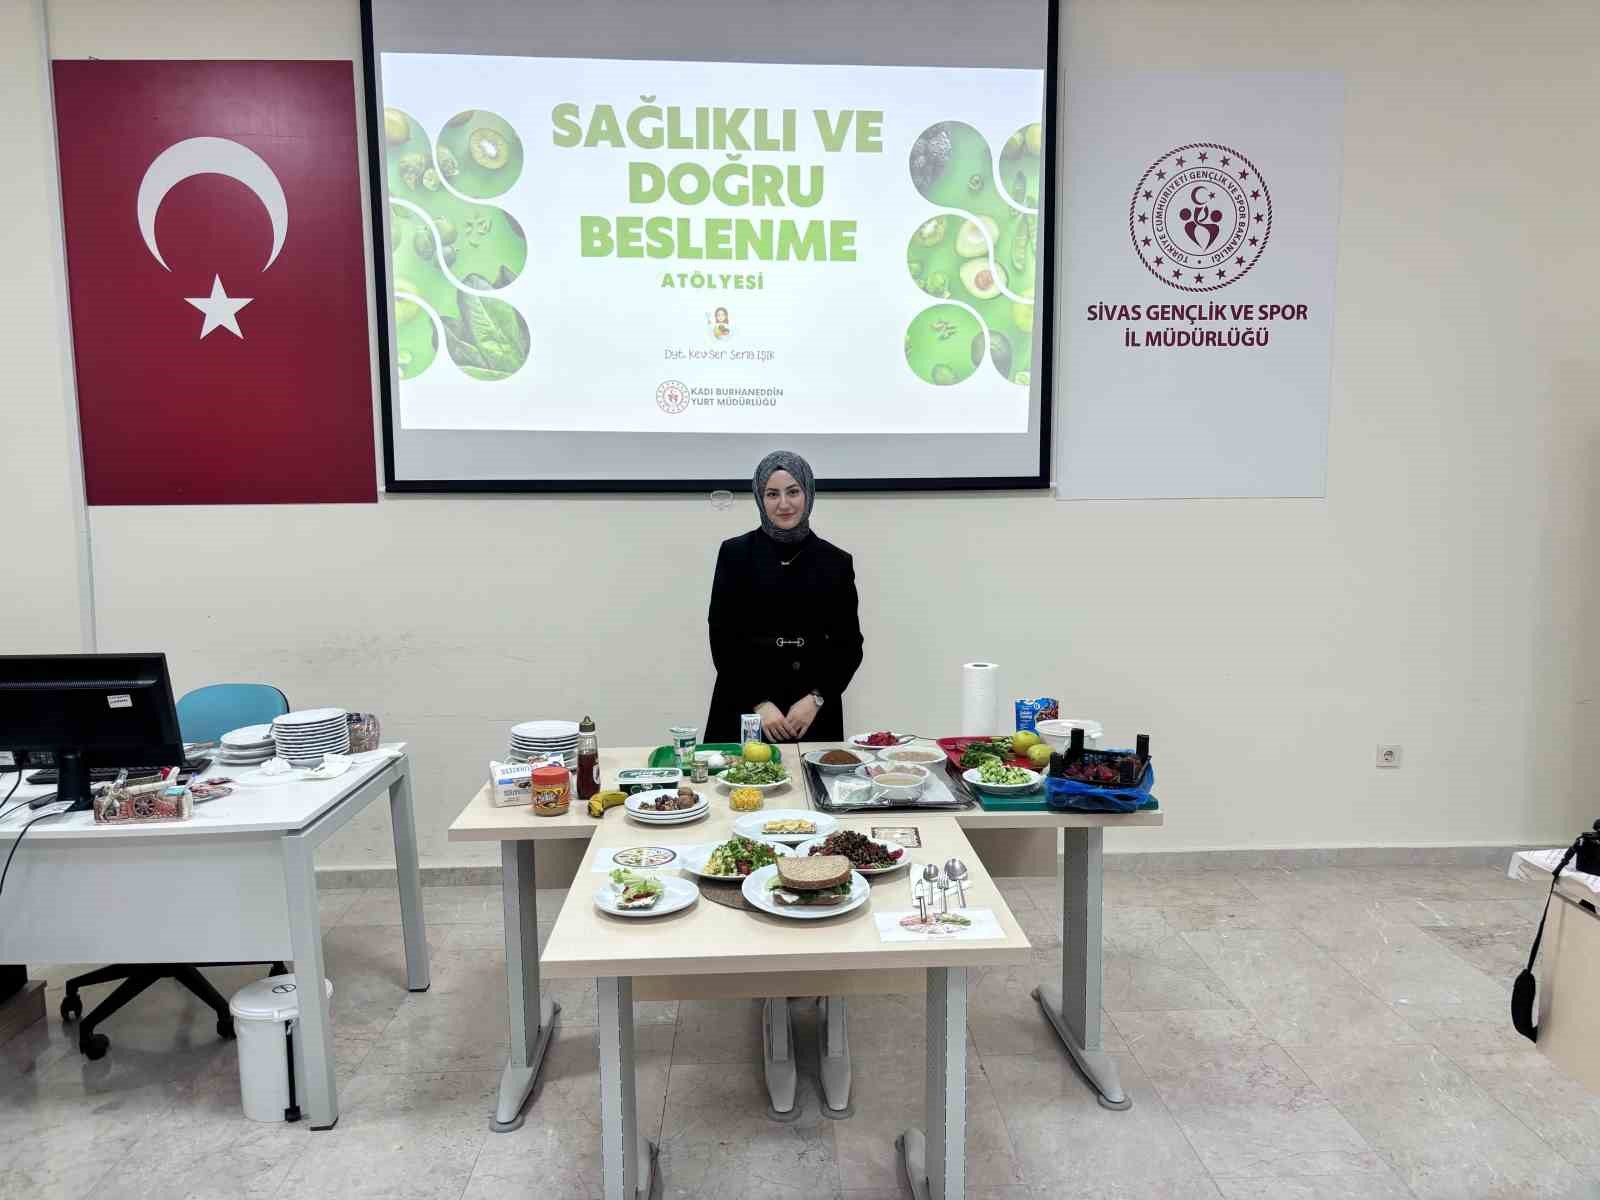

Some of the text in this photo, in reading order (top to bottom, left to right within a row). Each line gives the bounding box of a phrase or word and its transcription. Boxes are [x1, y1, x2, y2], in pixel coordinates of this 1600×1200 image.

[551, 95, 884, 153] SAĞLIKLI VE
[628, 153, 825, 208] DOĞRU
[1226, 183, 1239, 195] VE
[1234, 195, 1247, 219] SPOR
[580, 215, 858, 262] BESLENME
[660, 270, 765, 290] ATÖLYESİ
[1087, 301, 1309, 325] SİVAS GENÇLİK VE SPOR
[1124, 327, 1270, 347] İL MÜDÜRLÜĞÜ
[690, 387, 713, 397] KADI
[690, 397, 777, 407] YURT MÜDÜRLÜĞÜ
